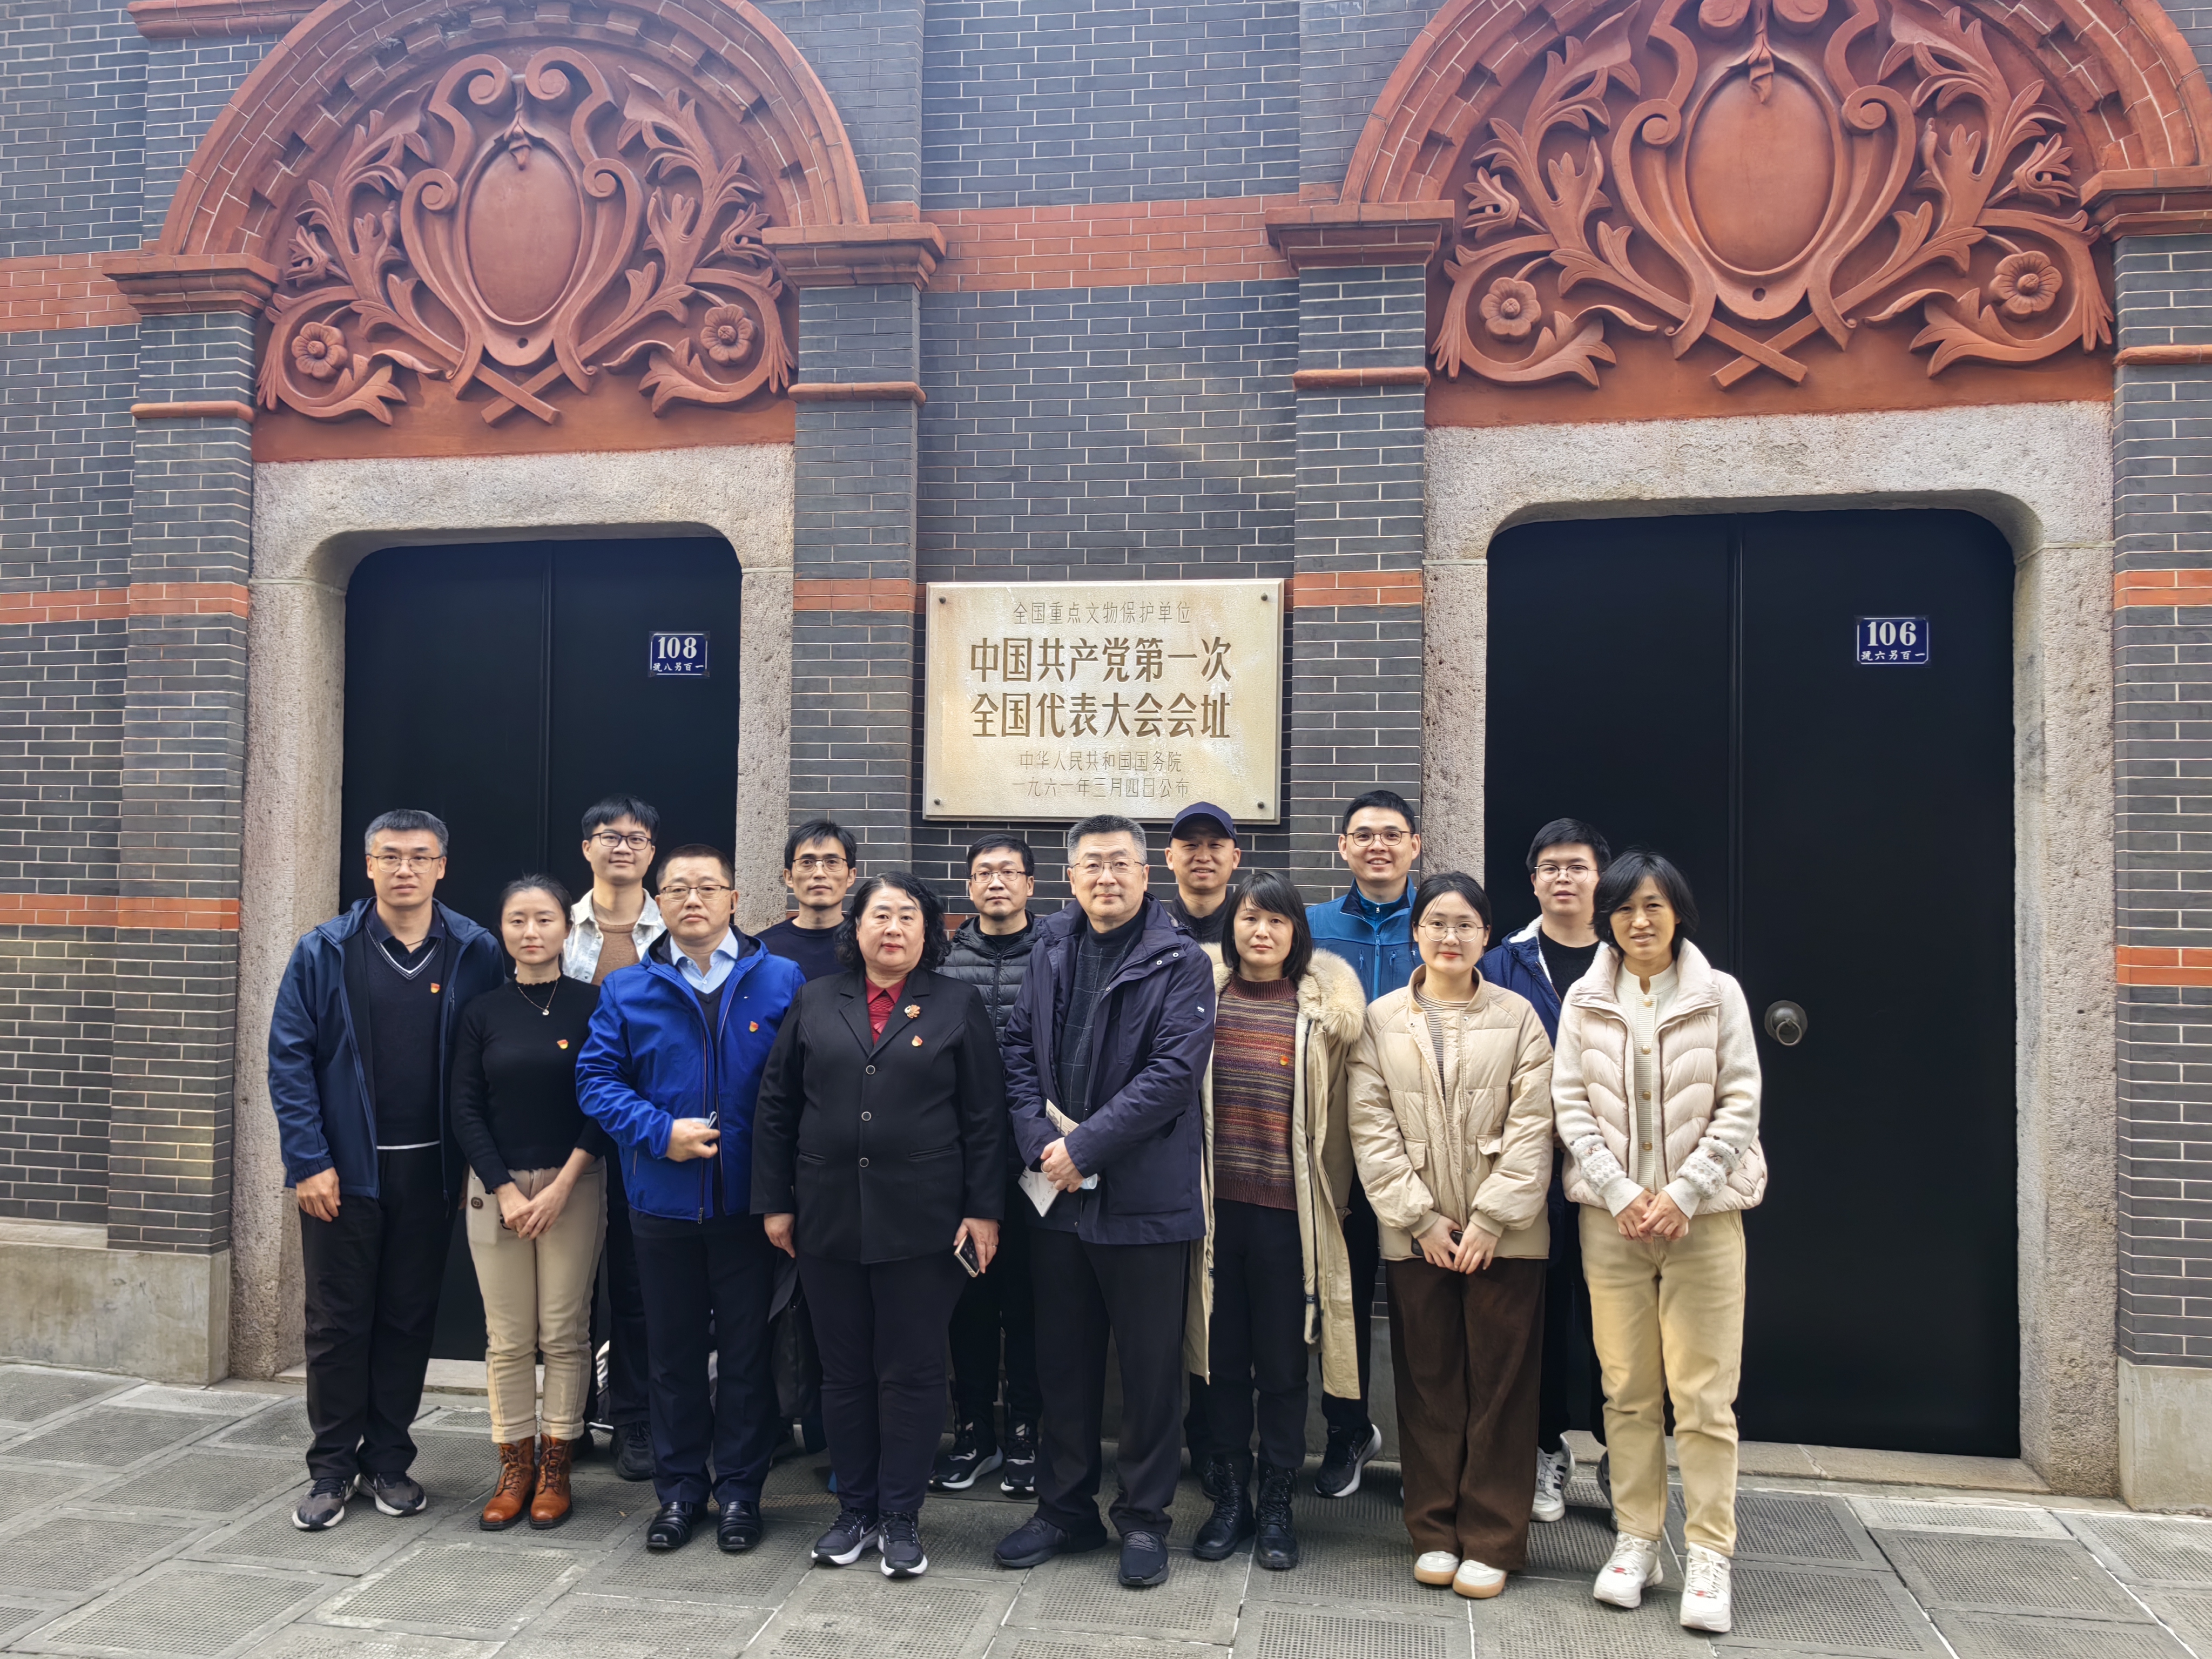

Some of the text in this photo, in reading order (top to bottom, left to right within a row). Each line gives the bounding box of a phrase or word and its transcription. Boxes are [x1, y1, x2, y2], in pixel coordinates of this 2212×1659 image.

[1013, 601, 1191, 624] 全国重点文物保护单位
[1867, 622, 1917, 646] 106
[658, 637, 697, 659] 108
[970, 636, 1232, 683] 中国共产党第一次
[970, 692, 1231, 738] 全国代表大会会址
[1020, 751, 1182, 773] 中华人民共和国国务院
[1011, 777, 1190, 799] 一九六一年三月四日公布
